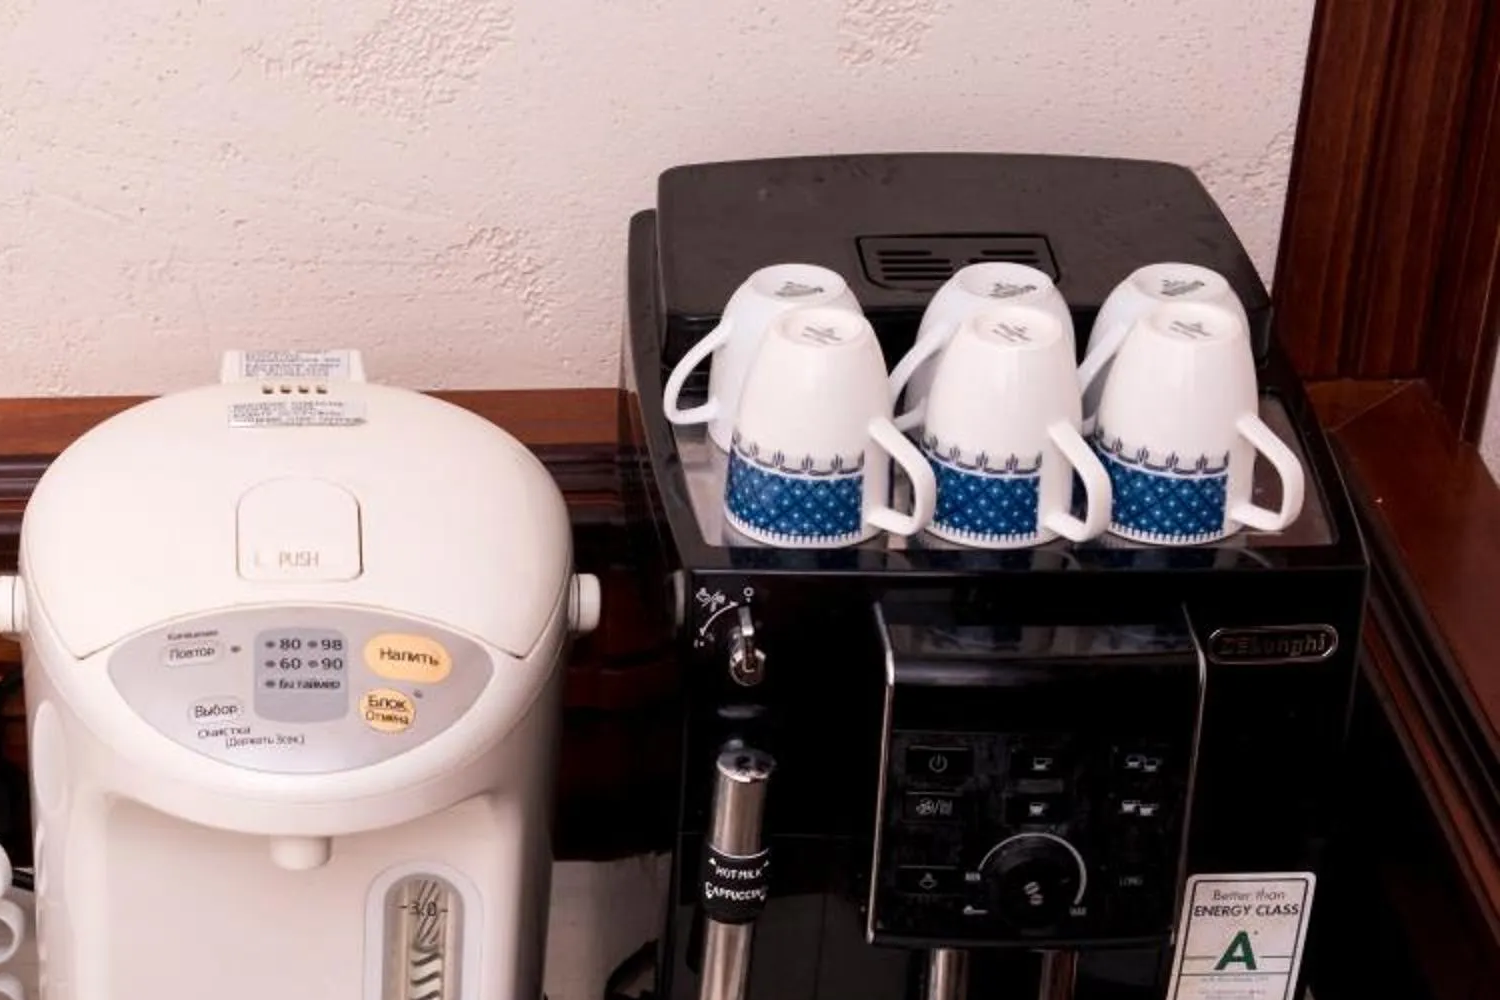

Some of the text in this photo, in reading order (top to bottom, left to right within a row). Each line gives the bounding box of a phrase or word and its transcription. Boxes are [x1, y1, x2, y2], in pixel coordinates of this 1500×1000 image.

[278, 551, 320, 568] PUSH
[279, 638, 343, 650] 80 98
[169, 646, 216, 662] Повтор
[379, 648, 442, 667] Налить
[279, 657, 343, 670] 60 90
[195, 704, 238, 718] Выбор
[1213, 888, 1285, 901] Better than
[1194, 903, 1300, 918] ENERGY CLASS
